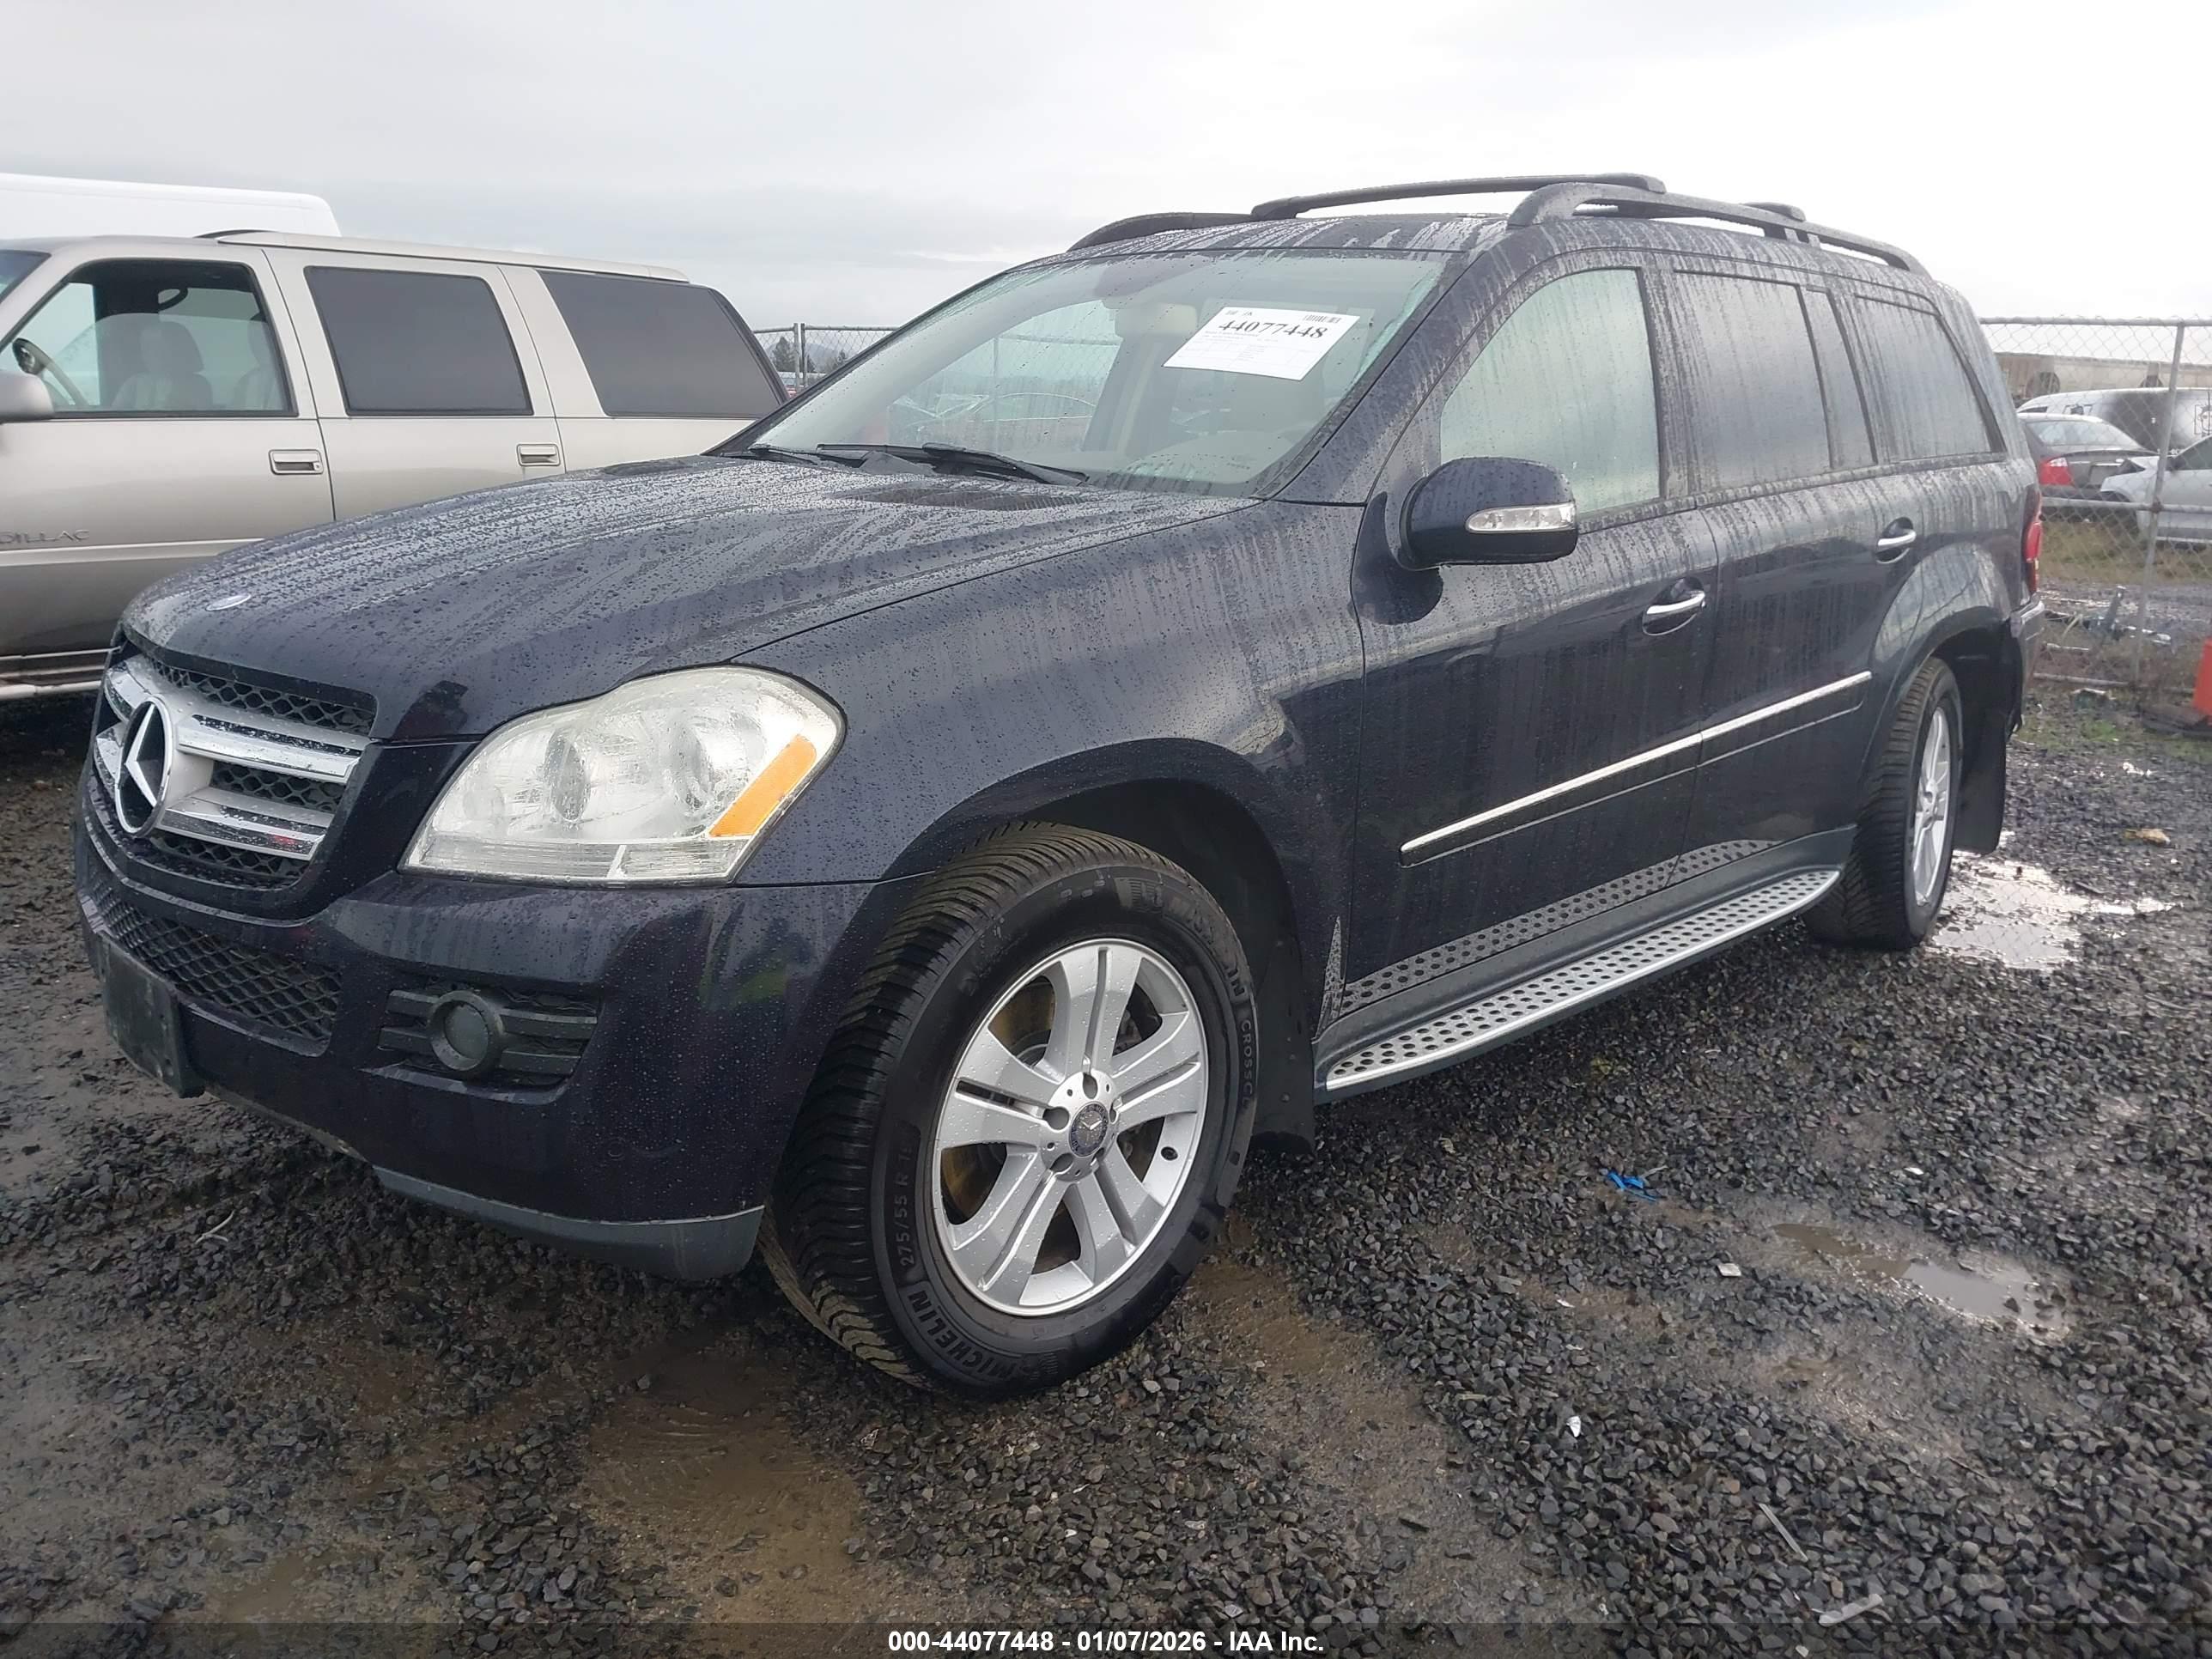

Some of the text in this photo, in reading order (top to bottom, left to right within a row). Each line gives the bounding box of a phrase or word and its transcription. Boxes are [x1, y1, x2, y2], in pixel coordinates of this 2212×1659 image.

[1218, 319, 1328, 339] 44077448
[894, 1194, 915, 1267] 275/55
[907, 1290, 1016, 1380] MICHELIN
